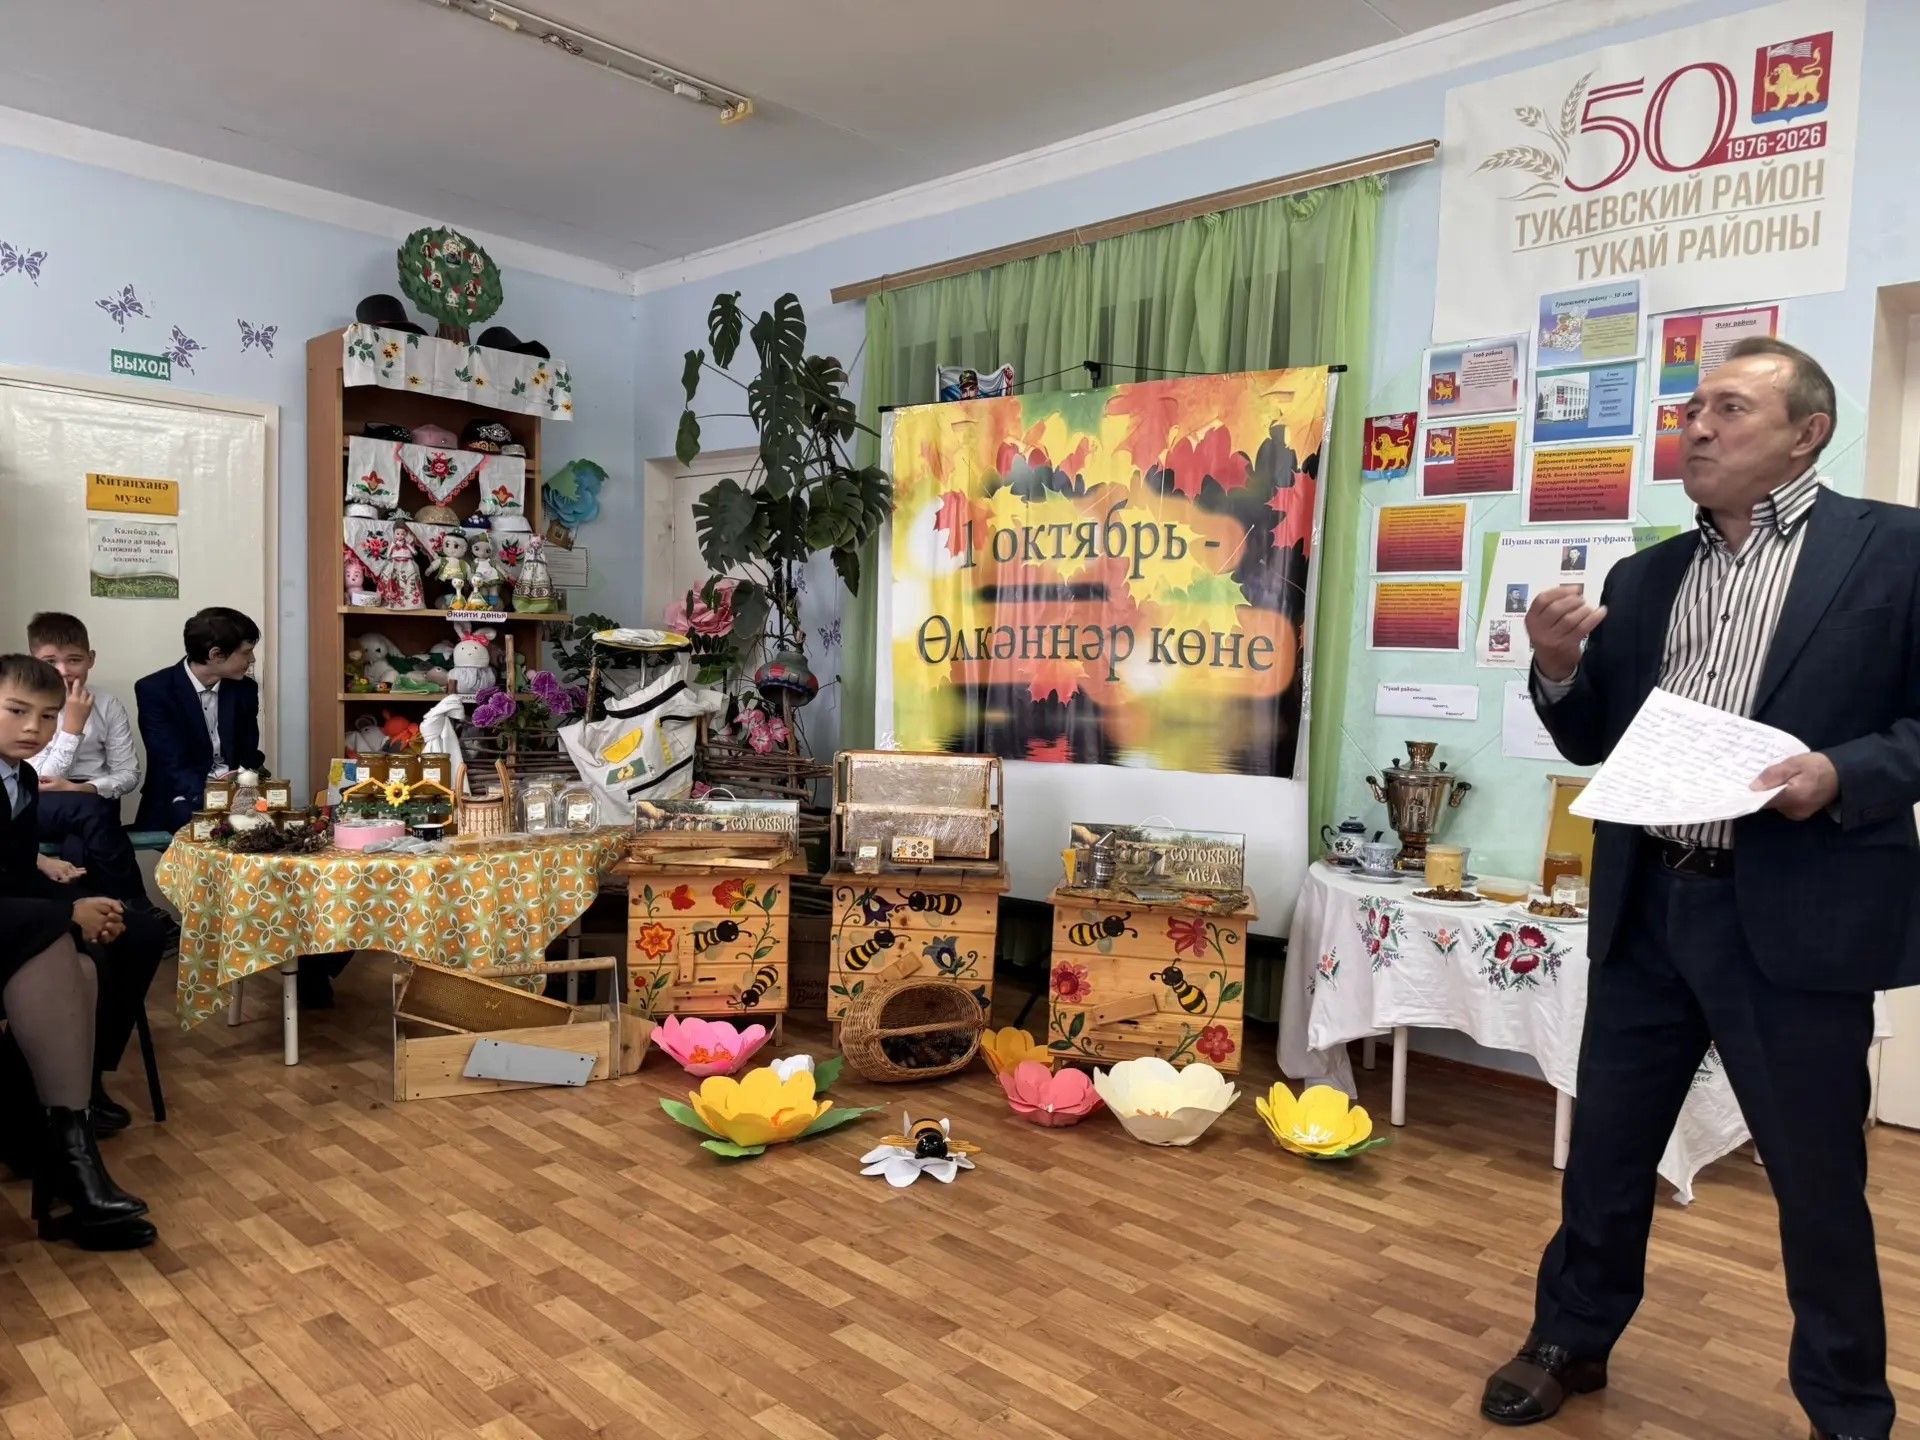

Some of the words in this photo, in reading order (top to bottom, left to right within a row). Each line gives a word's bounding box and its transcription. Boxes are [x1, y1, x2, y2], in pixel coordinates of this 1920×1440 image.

[1565, 62, 1737, 191] 50
[1726, 126, 1821, 160] 1976-2026
[1515, 173, 1704, 247] ТУКАЕВСКИЙ
[1712, 158, 1825, 210] РАЙОН
[1575, 225, 1668, 280] ТУКАЙ
[1677, 210, 1821, 264] РАЙОНЫ
[113, 354, 169, 378] ВЫХОД
[95, 474, 169, 491] Китапханә
[114, 494, 152, 505] музее
[960, 519, 978, 569] 1
[992, 498, 1188, 579] октябрь
[1562, 536, 1590, 546] шушы
[480, 612, 507, 620] дөнья
[917, 614, 1135, 681] Өлкәннәр
[1149, 625, 1275, 671] көне
[731, 815, 794, 831] СОТОВЫЙ
[1170, 848, 1239, 865] СОТОВЫЙ
[1186, 865, 1222, 885] МЁД
